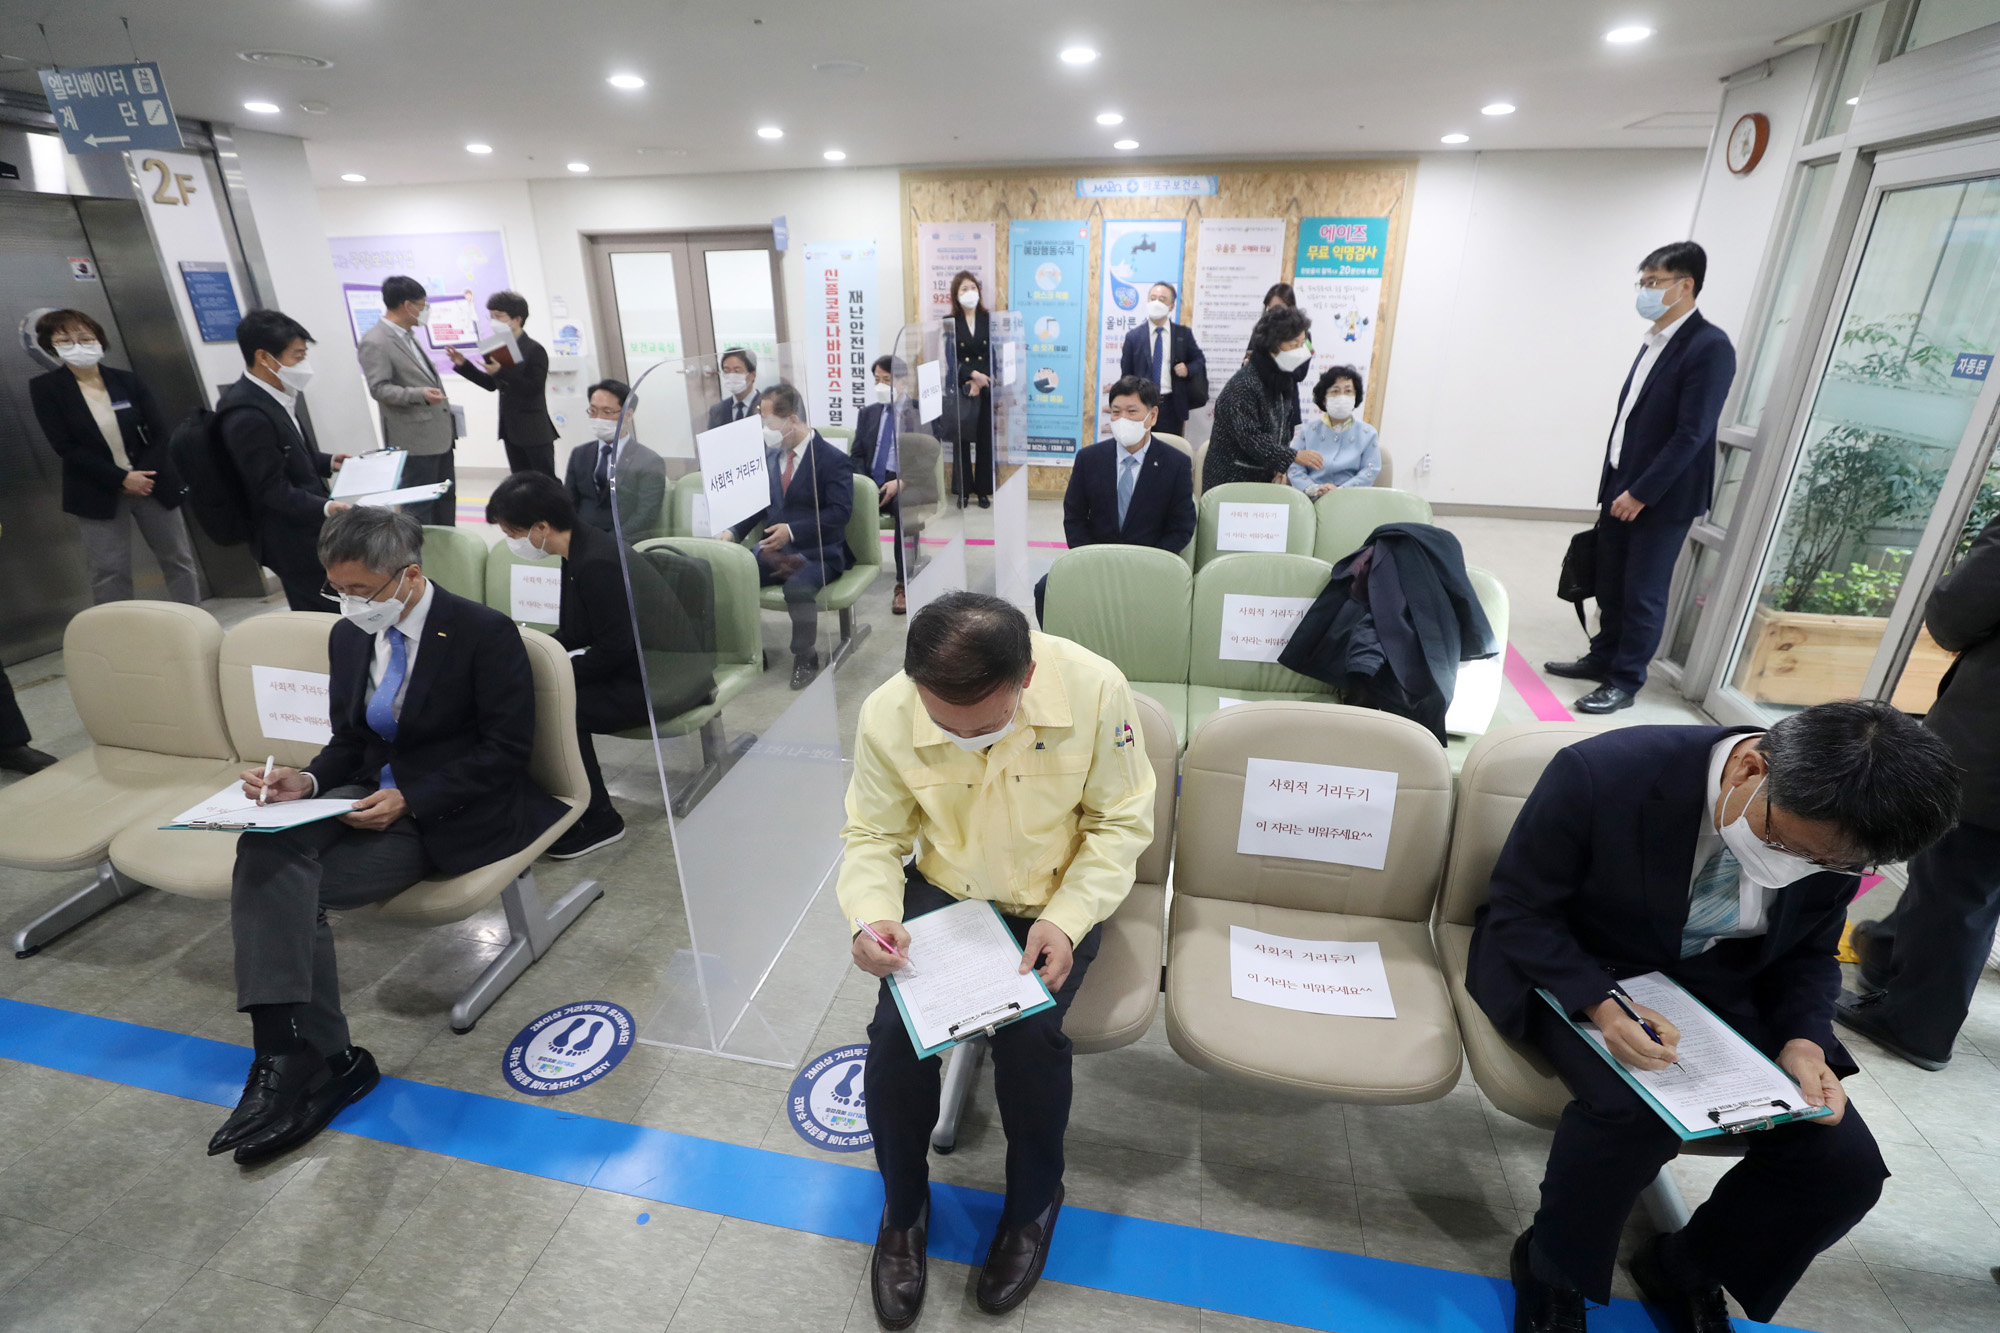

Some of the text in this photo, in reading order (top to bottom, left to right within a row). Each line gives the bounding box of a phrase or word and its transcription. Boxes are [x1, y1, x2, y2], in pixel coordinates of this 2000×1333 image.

[47, 69, 129, 100] 엘리베이터
[143, 158, 196, 205] 2F
[1143, 179, 1201, 191] 마포구보건소
[1320, 224, 1367, 242] 에이즈
[1307, 245, 1378, 262] 무료 익명검사
[824, 268, 842, 392] 신종코로나바이러스
[1105, 316, 1137, 330] 올바른
[848, 290, 865, 410] 재난안전대책본부
[1956, 358, 1987, 375] 자동문
[828, 396, 843, 426] 감염
[710, 456, 764, 492] 사회적 거리두기
[1238, 606, 1265, 618] 사회적
[1231, 636, 1239, 644] 이
[1241, 636, 1262, 646] 자리는
[269, 681, 296, 692] 사회적
[1269, 778, 1370, 801] 사회적 거리두기
[1256, 820, 1373, 841] 이 자리는 비워주세요^^
[1254, 943, 1356, 964] 사회적 거리두기
[1247, 972, 1373, 996] 이 자리는 비워주세요^^
[530, 1011, 563, 1032] 2M이상
[804, 1056, 834, 1080] 2M이상
[793, 1096, 807, 1121] 주세요
